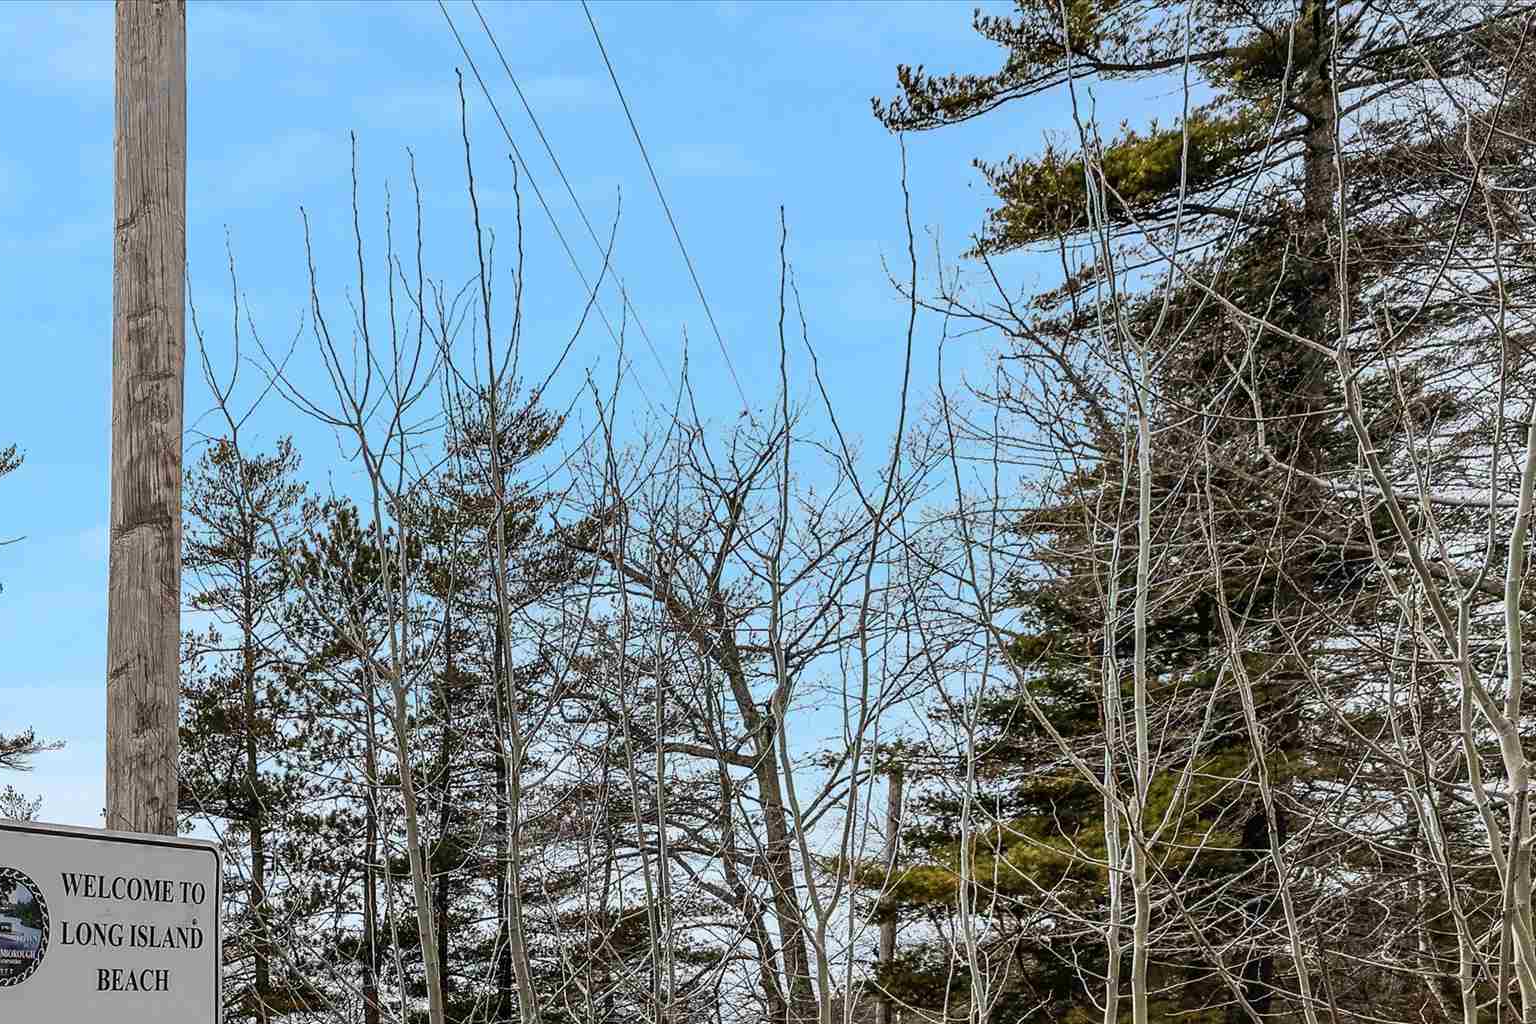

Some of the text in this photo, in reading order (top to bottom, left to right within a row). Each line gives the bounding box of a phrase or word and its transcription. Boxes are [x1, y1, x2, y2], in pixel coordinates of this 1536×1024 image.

[61, 872, 206, 905] WELCOME TO
[60, 920, 204, 949] LONG ISLAND
[96, 968, 169, 992] BEACH
